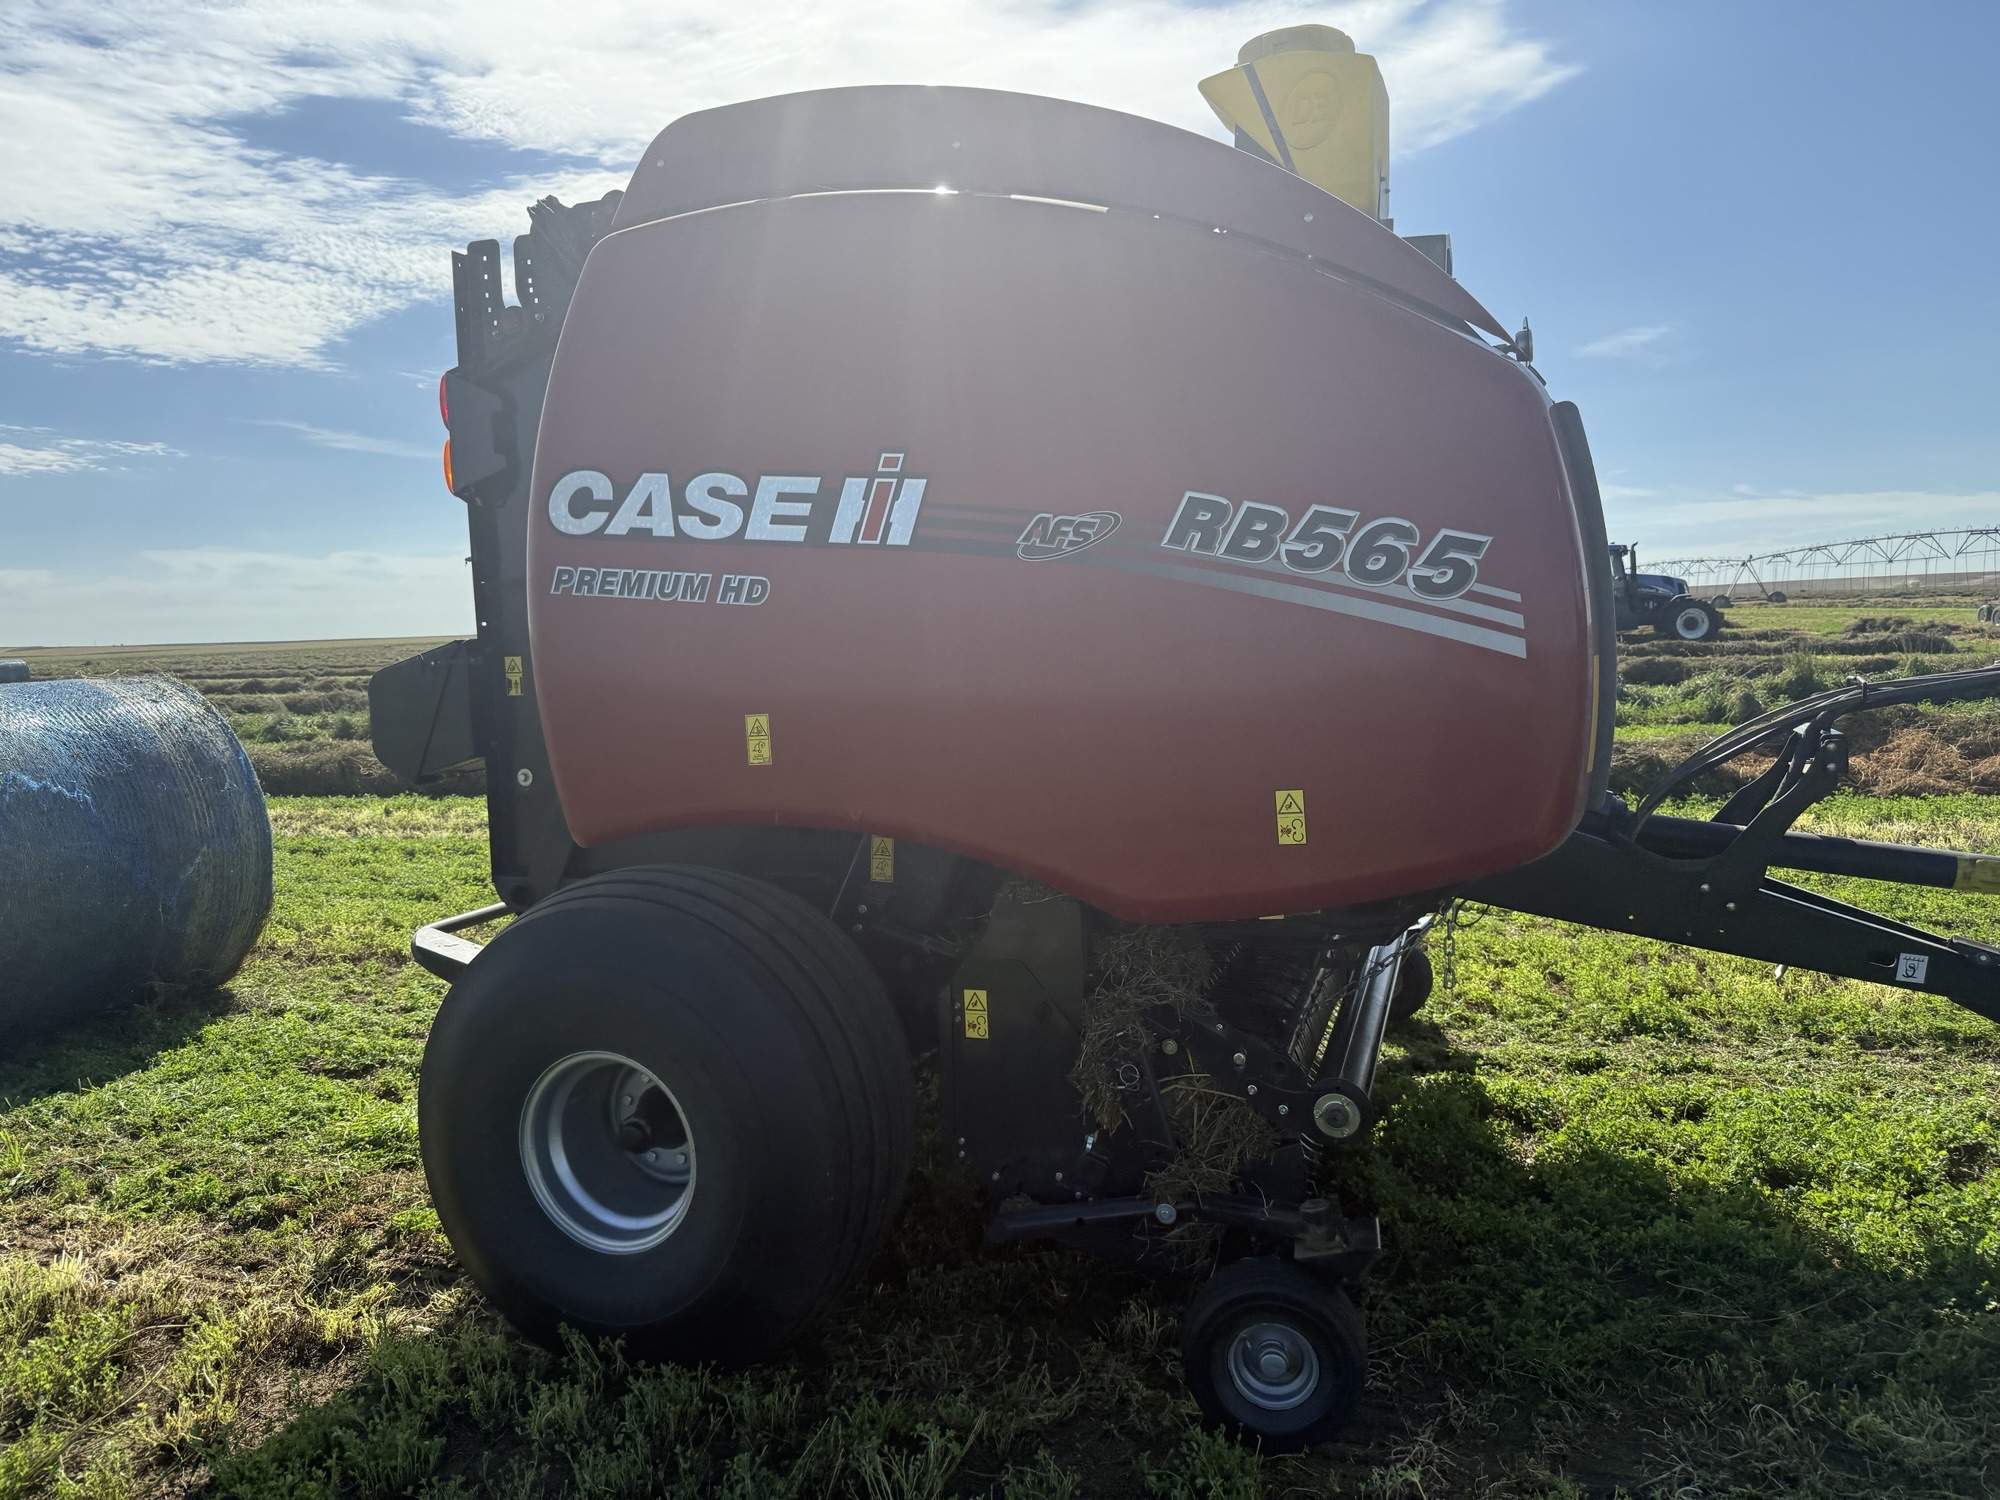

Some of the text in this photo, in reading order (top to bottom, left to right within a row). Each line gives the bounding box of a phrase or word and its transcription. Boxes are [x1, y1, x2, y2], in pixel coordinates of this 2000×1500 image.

[548, 469, 821, 541] CASE
[1016, 512, 1100, 551] AFS
[1161, 490, 1494, 602] RB565
[551, 566, 771, 605] PREMIUM HD
